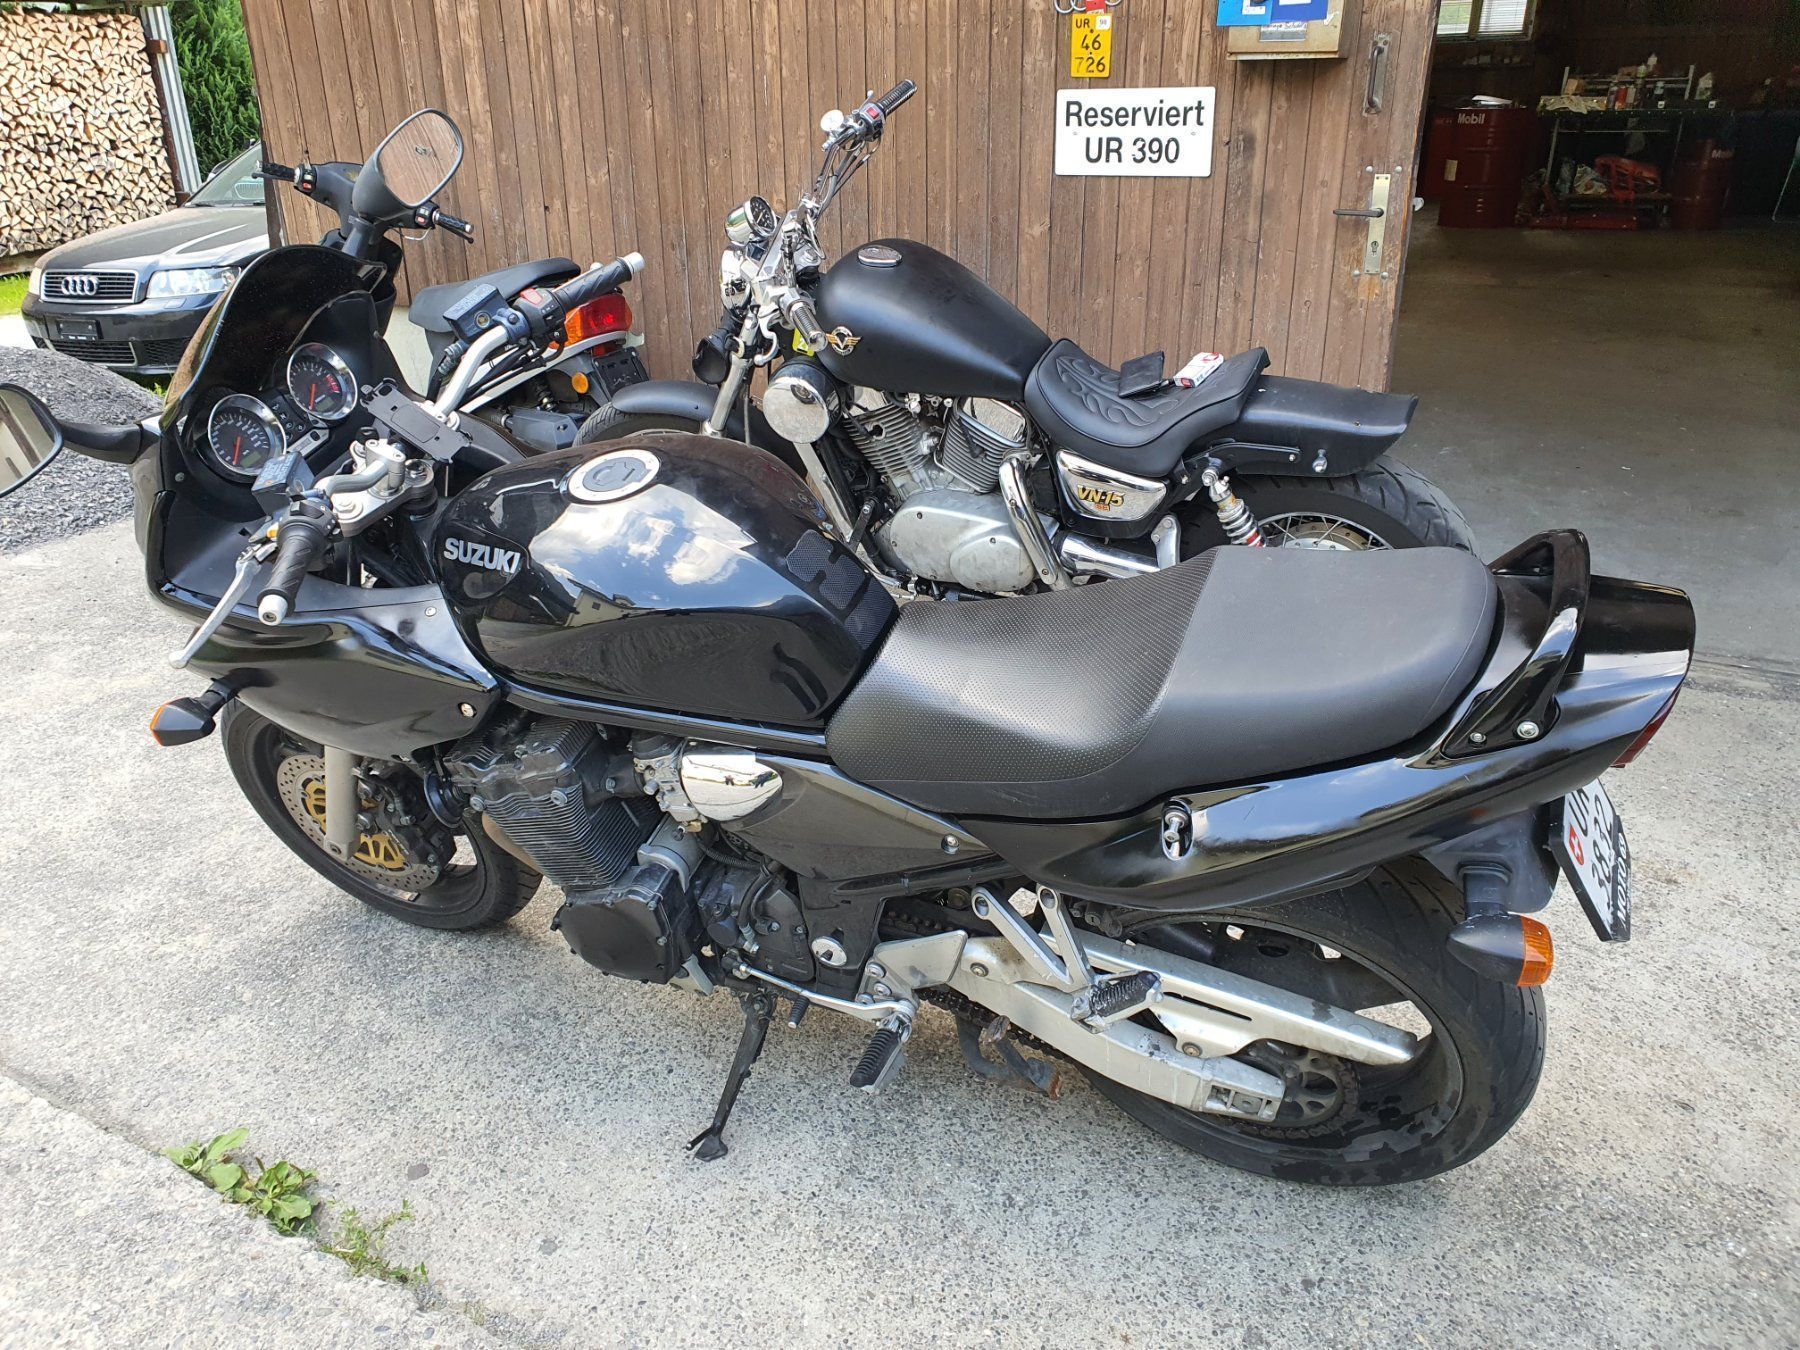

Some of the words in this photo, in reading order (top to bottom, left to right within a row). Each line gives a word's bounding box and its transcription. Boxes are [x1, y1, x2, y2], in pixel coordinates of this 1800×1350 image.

[1075, 18, 1090, 29] UR
[1081, 33, 1102, 51] 46
[1074, 56, 1106, 73] 726
[1065, 98, 1205, 127] Reserviert
[1457, 112, 1486, 125] Mobil
[1085, 136, 1123, 163] UR
[1131, 136, 1180, 164] 390
[443, 537, 521, 574] SUZUKI
[1592, 793, 1613, 911] 3832
[1617, 856, 1628, 932] MOTO
